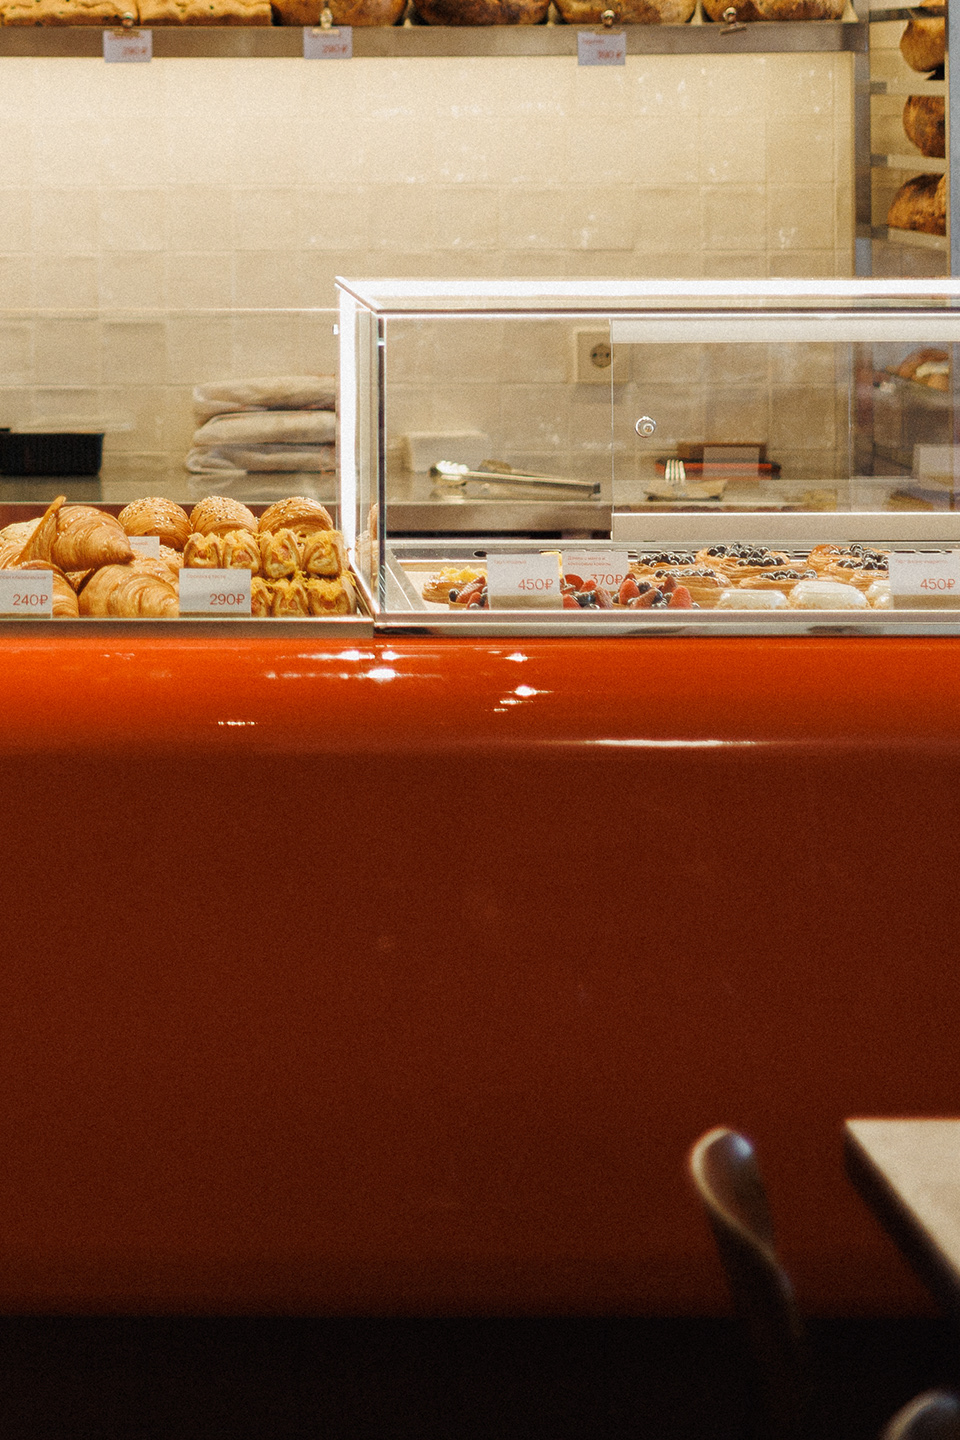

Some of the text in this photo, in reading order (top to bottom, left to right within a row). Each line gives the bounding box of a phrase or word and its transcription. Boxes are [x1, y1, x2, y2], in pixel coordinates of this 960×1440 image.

[518, 578, 554, 590] 450₽
[920, 578, 956, 590] 450₽
[12, 594, 48, 606] 240₽
[209, 593, 245, 606] 290₽
